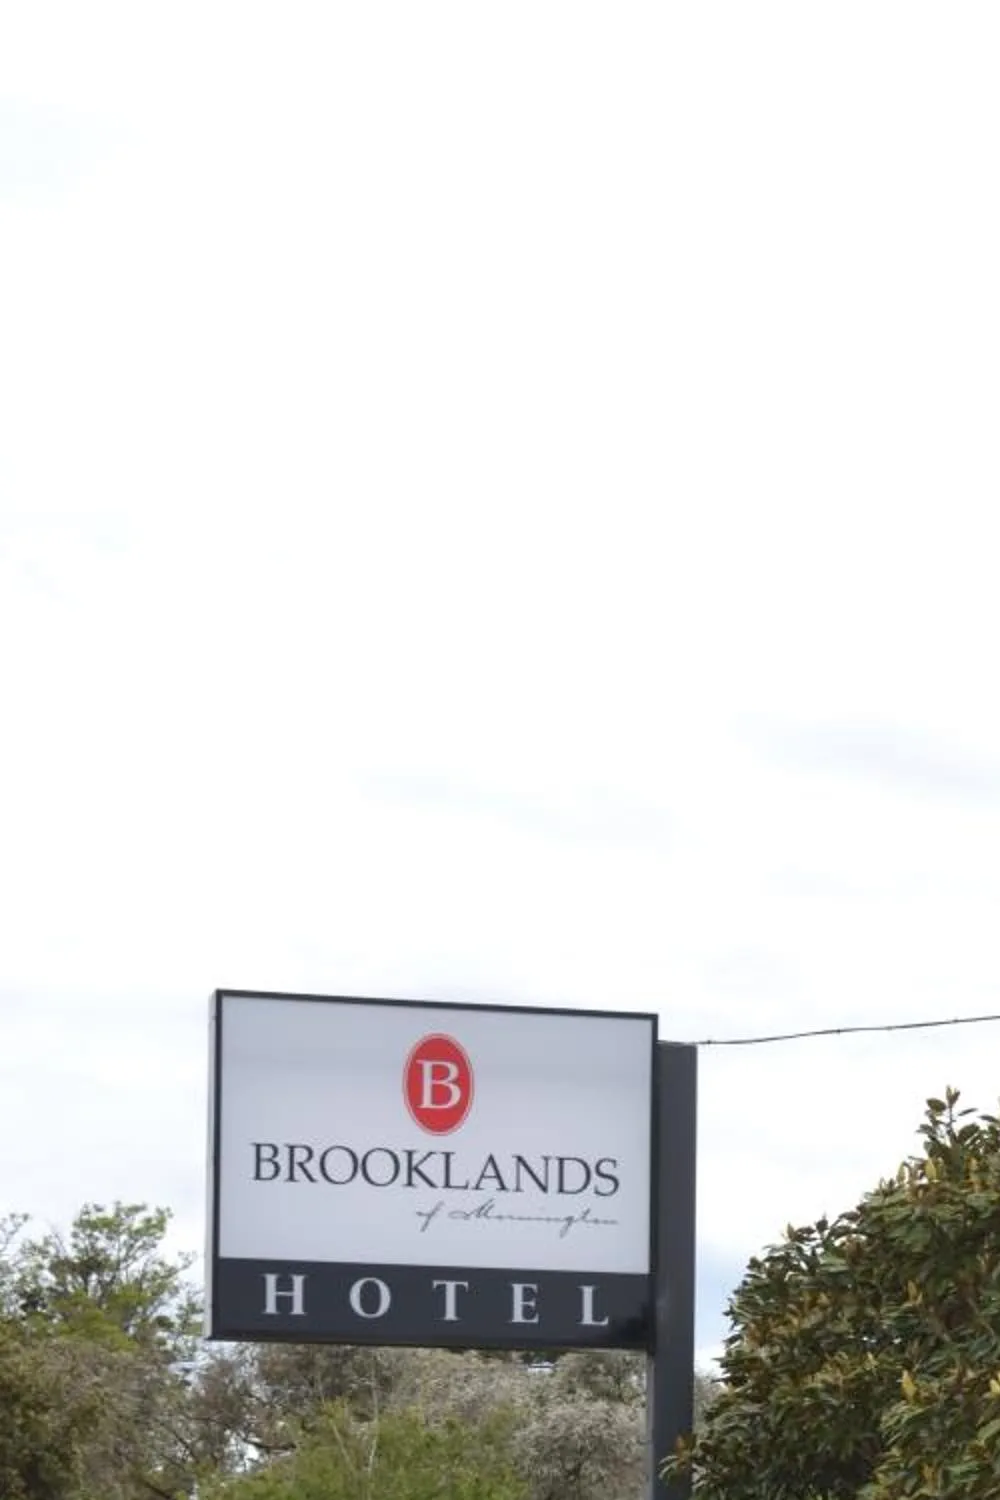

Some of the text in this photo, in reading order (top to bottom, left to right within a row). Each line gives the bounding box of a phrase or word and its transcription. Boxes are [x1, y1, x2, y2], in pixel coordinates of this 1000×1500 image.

[416, 1060, 462, 1109] B
[251, 1142, 620, 1197] BROOKLANDS
[263, 1274, 609, 1327] HOTEL
